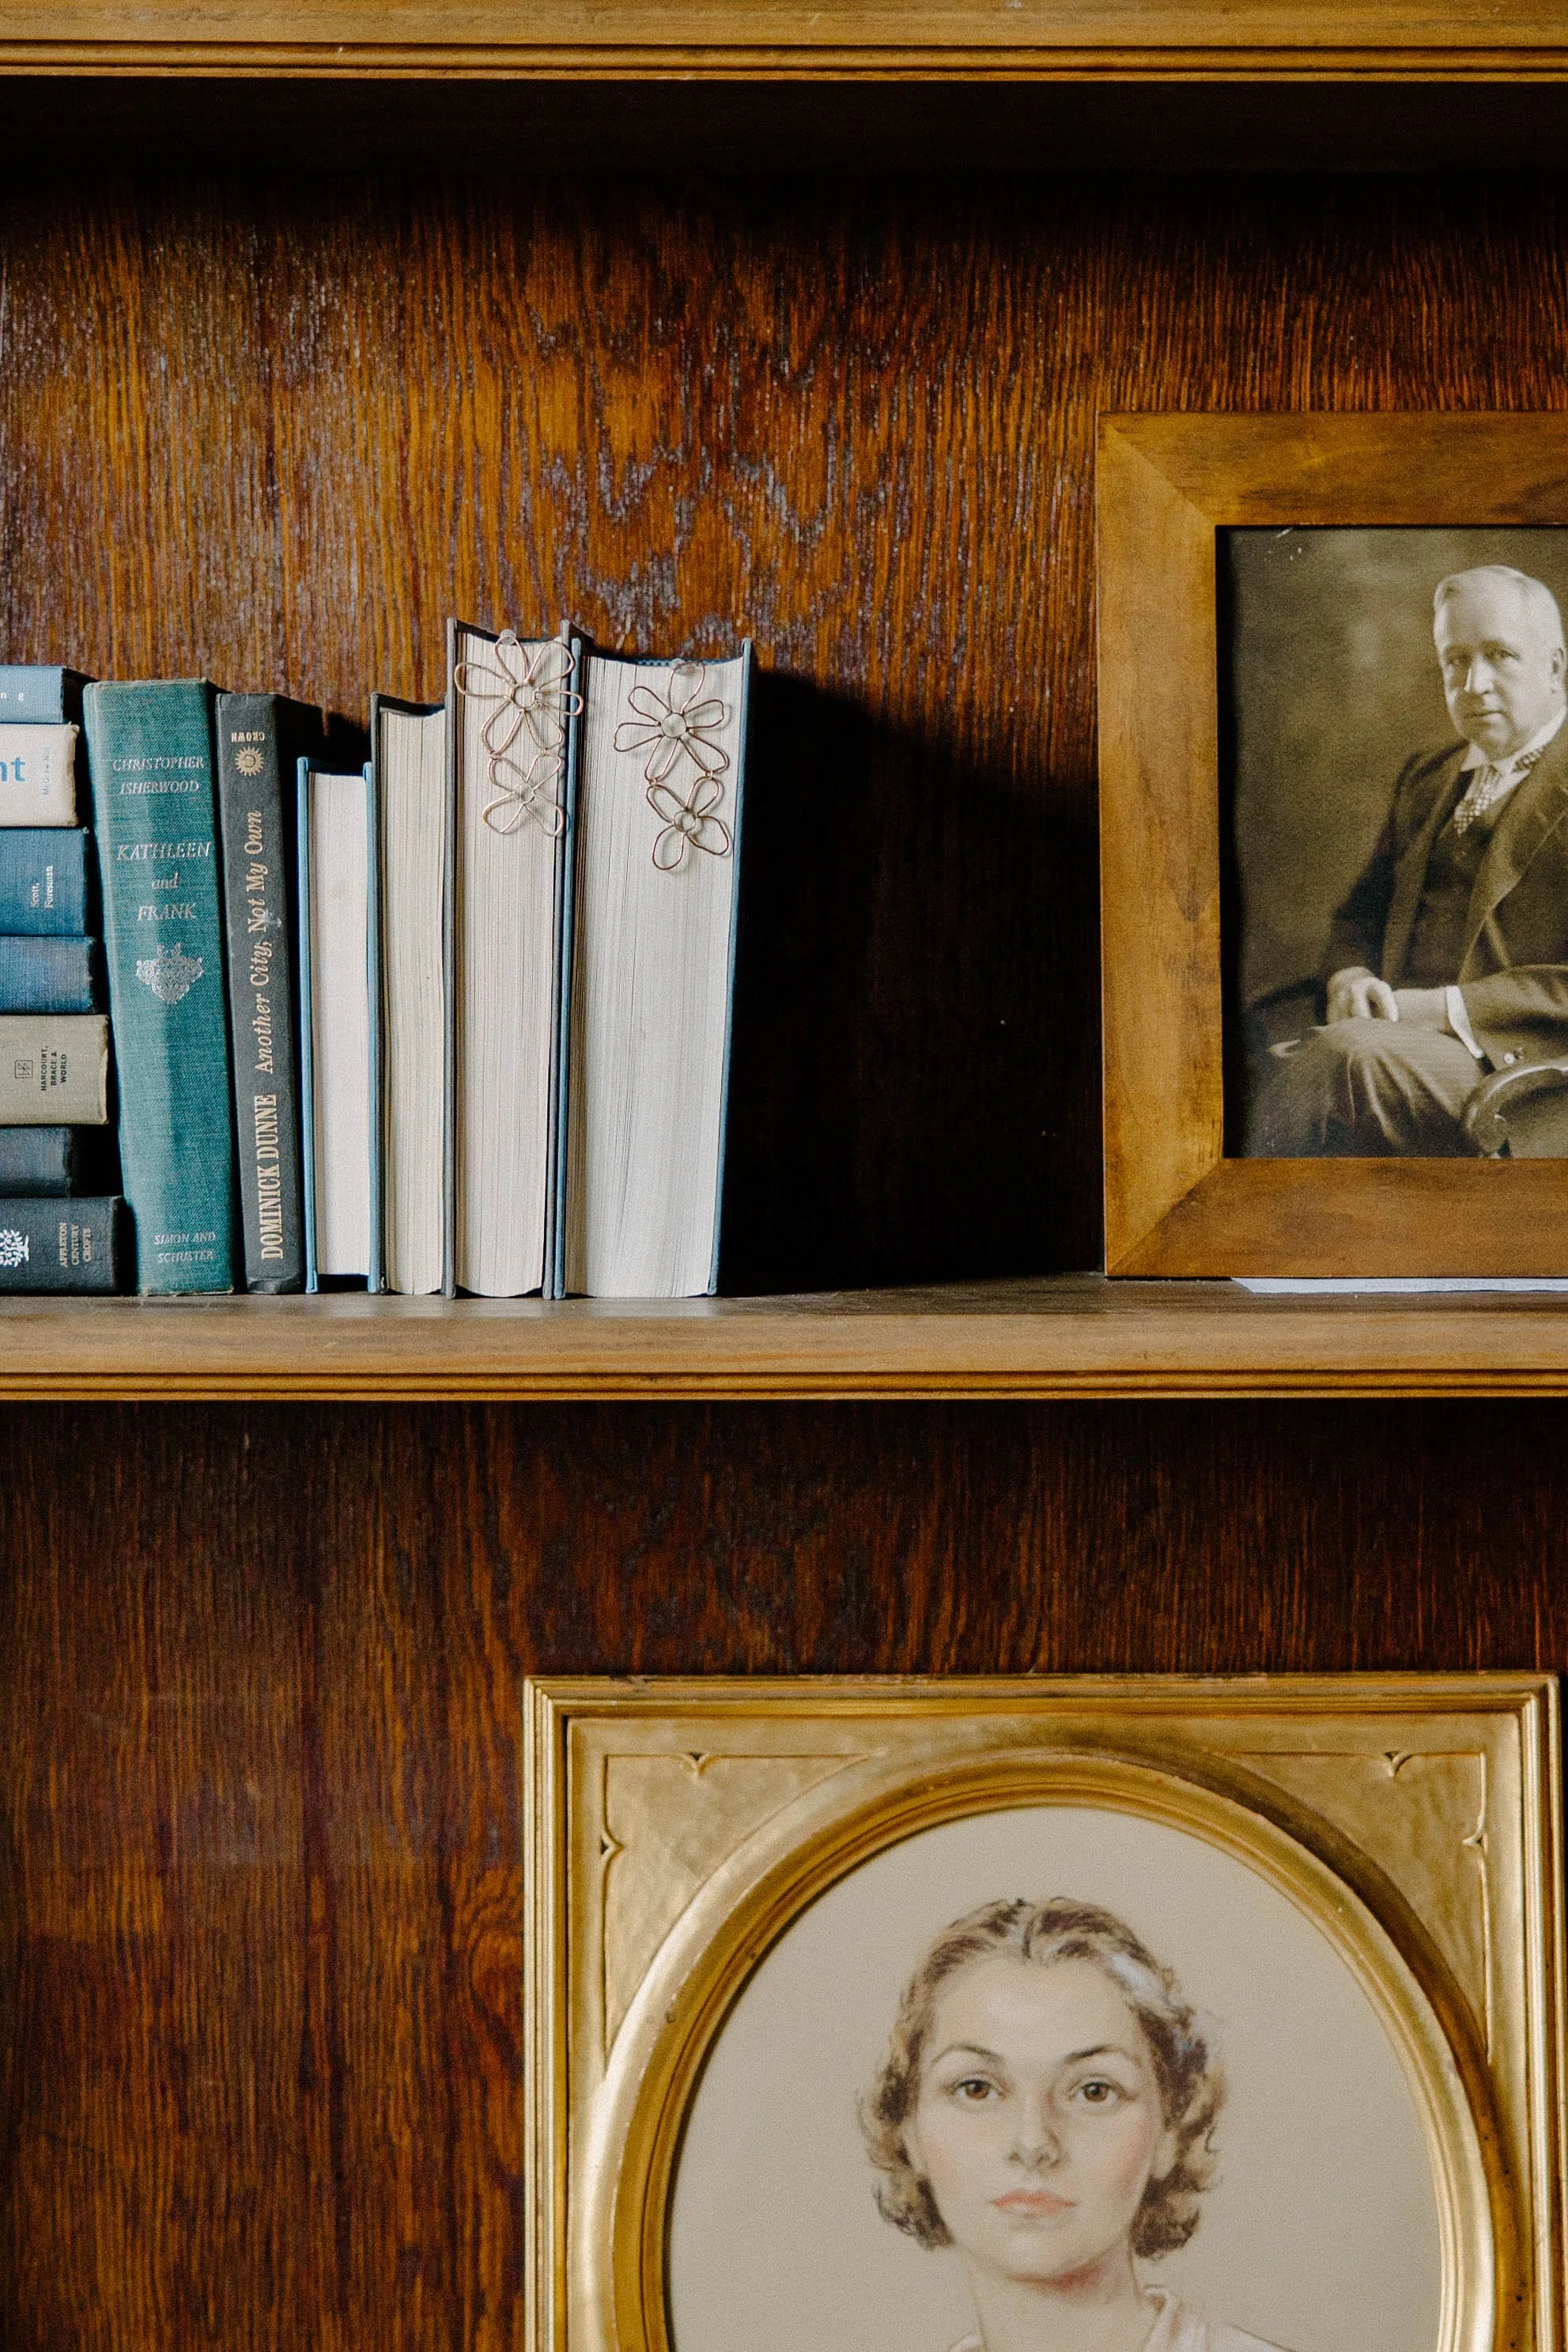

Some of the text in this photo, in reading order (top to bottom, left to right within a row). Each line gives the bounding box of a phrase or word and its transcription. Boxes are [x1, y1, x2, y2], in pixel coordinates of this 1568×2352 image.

[231, 731, 266, 743] CROWN
[113, 755, 206, 772] CHRISTOPHER
[120, 780, 201, 795] ISHERWOOD
[117, 841, 211, 860] KATHLEEN
[44, 865, 54, 908] Foresman
[152, 872, 178, 890] and
[31, 883, 40, 907] Scott,
[138, 903, 196, 921] FRANK
[244, 810, 274, 1074] Another City, Not My Own
[254, 1094, 284, 1260] DOMINICK DUNNE
[59, 1222, 68, 1268] APPLETON
[70, 1223, 79, 1265] CENTURY
[82, 1227, 92, 1262] CROFTS
[153, 1231, 217, 1246] SIMON AND
[157, 1250, 216, 1264] SCHUSTER
